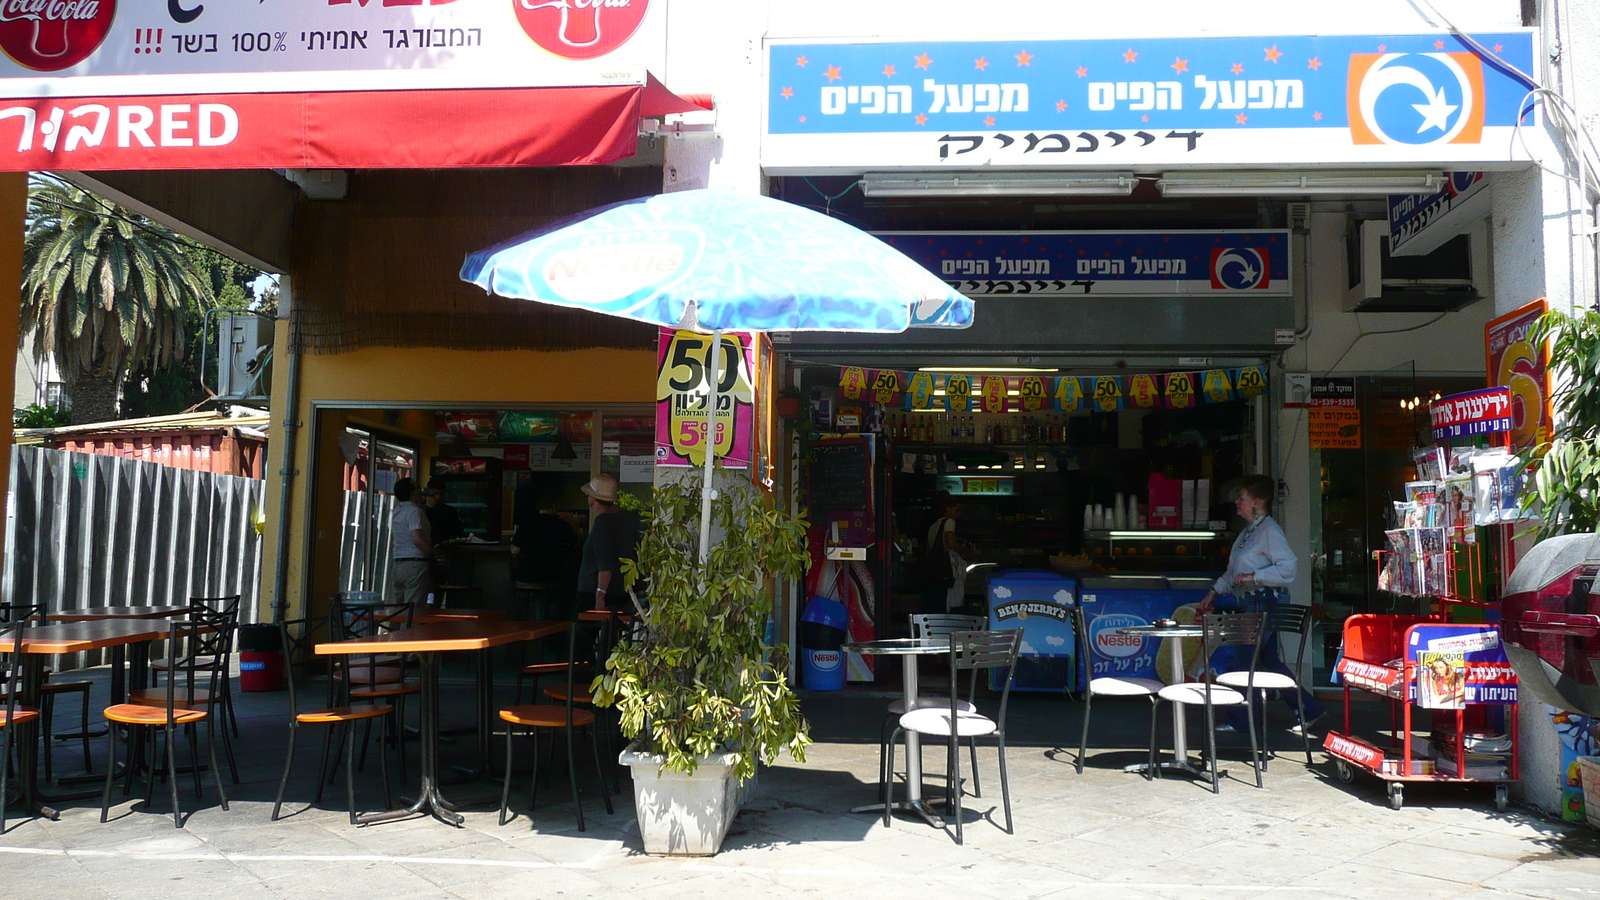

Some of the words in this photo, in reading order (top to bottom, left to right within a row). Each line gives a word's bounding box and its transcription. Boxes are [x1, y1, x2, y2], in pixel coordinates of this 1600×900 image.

[134, 28, 163, 54] !!!
[171, 33, 218, 53] בשר
[231, 31, 288, 52] 100%
[300, 30, 368, 50] אמיתי
[382, 28, 482, 48] המבורגר
[820, 85, 912, 115] הפיס
[923, 78, 1029, 114] מפעל
[1088, 80, 1183, 111] הפיס
[1194, 74, 1304, 110] מפעל
[117, 103, 239, 148] RED
[937, 129, 1205, 159] דיינמיק
[1391, 192, 1452, 253] דיינמיק
[942, 258, 990, 275] הפיס
[995, 256, 1050, 275] מפעל
[1076, 258, 1125, 275] הפיס
[1131, 256, 1187, 275] מפעל
[669, 338, 739, 393] 50
[876, 374, 896, 389] 50
[948, 379, 968, 395] 50
[1022, 381, 1041, 396] 50
[1097, 381, 1116, 396] 50
[1168, 377, 1189, 392] 50
[1240, 371, 1260, 387] 50
[1454, 392, 1508, 421] ידיעות
[1324, 411, 1358, 422] במקום
[679, 420, 700, 446] 5
[1093, 661, 1110, 673] זה
[1113, 657, 1131, 671] על
[1134, 654, 1152, 672] לק
[1480, 687, 1517, 701] העיתון
